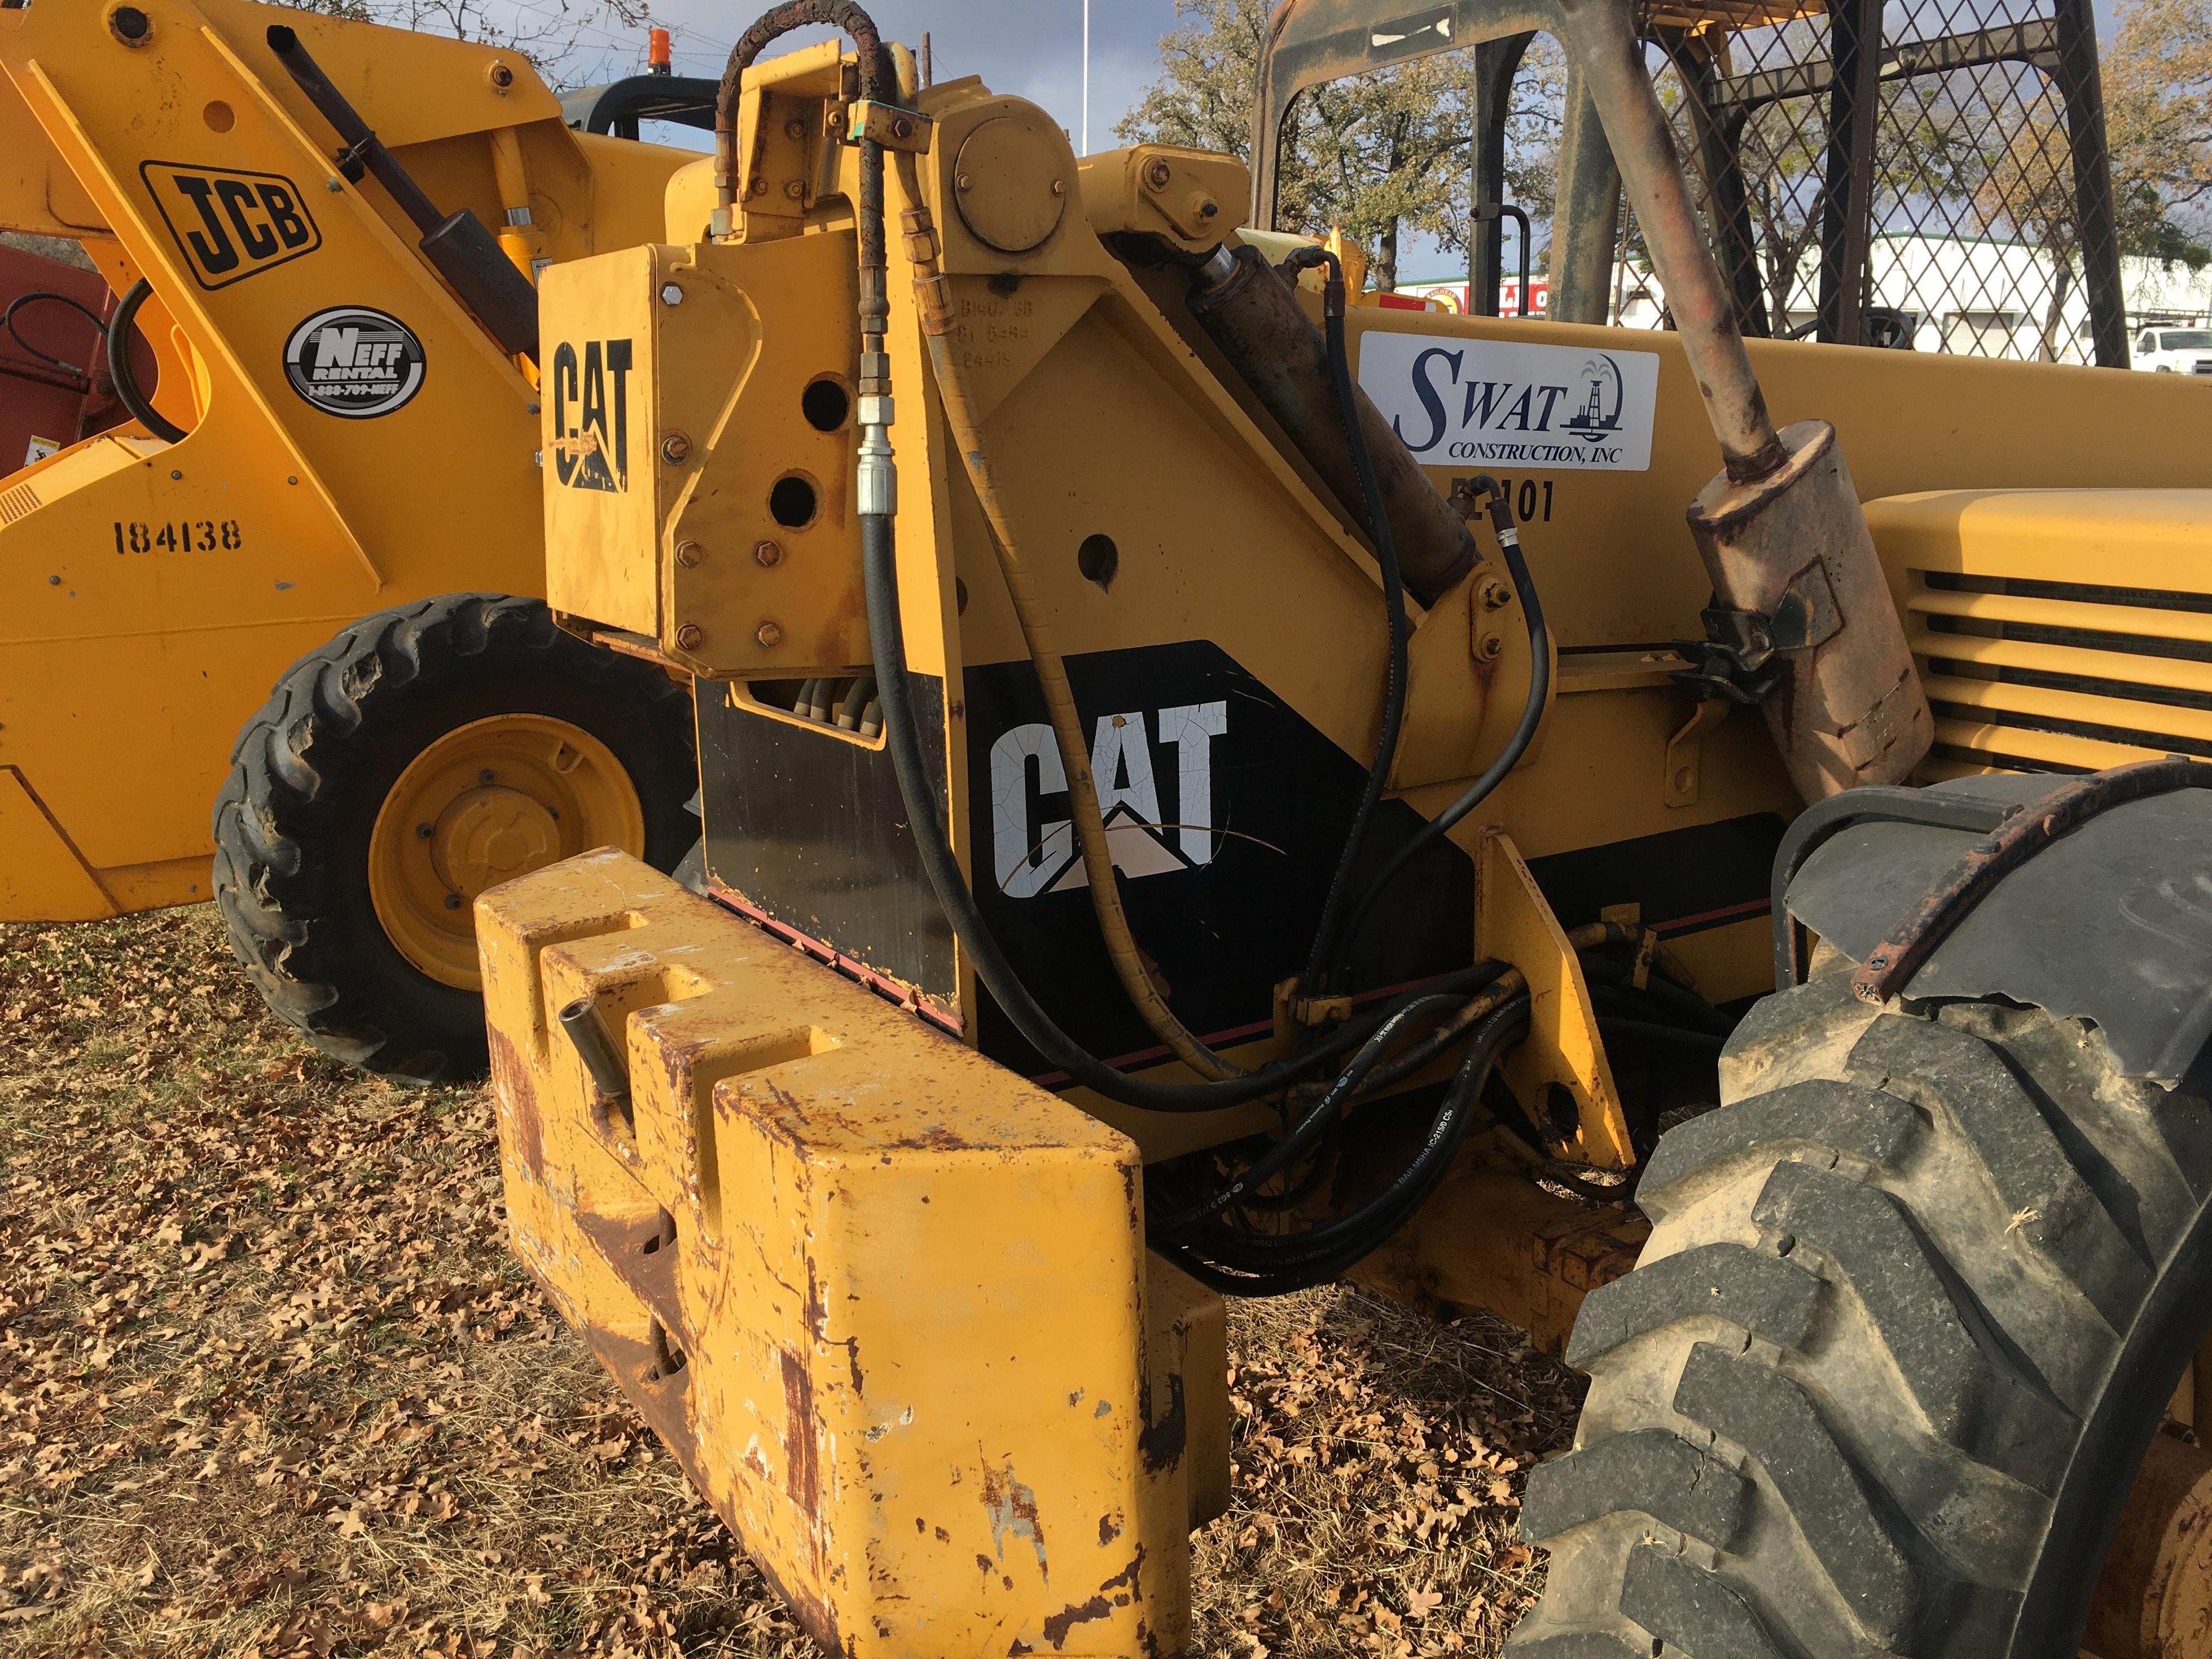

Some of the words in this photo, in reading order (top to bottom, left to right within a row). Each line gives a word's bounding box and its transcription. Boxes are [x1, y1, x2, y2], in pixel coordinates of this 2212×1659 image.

[172, 175, 309, 274] JCB
[1426, 289, 1456, 299] RAILHEAD
[315, 327, 403, 367] NEFF
[308, 384, 399, 397] 1-888-709-NEFF
[312, 366, 397, 380] RENTAL
[554, 338, 632, 494] CAT
[1392, 348, 1568, 452] SWAT
[1448, 441, 1586, 464] CONSTRUCTION,
[1590, 447, 1623, 463] INC
[114, 520, 241, 554] 184138
[990, 700, 1228, 898] CAT
[1398, 1168, 1415, 1184] BAR
[1412, 1147, 1432, 1169] MSHA
[1285, 1254, 1305, 1264] BAR
